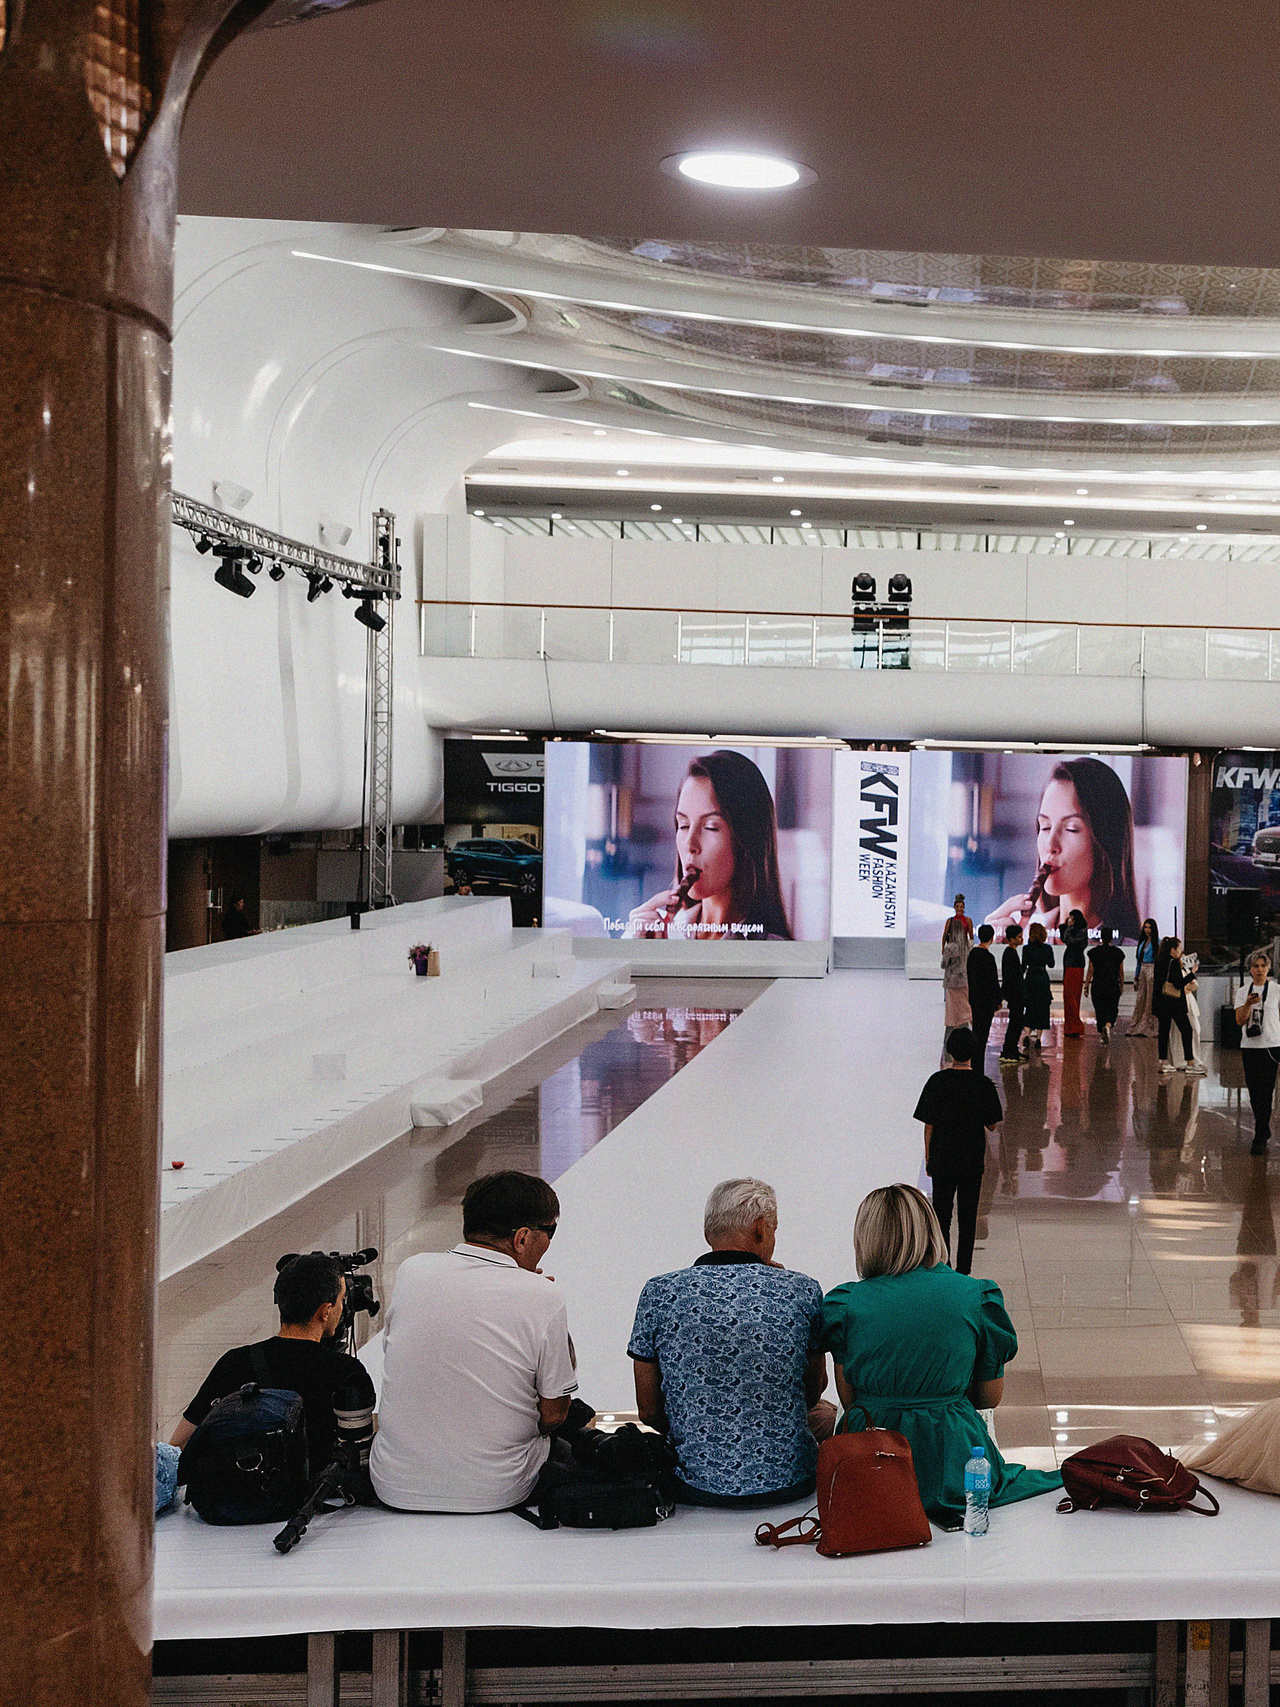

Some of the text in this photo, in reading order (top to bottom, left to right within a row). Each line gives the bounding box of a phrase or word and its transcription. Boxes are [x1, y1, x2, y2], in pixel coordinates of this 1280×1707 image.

[1215, 766, 1280, 790] KFW
[859, 761, 899, 861] KFW
[858, 853, 871, 882] WEEK
[871, 857, 884, 899] FASHION
[884, 862, 897, 930] KAZAKHSTAN
